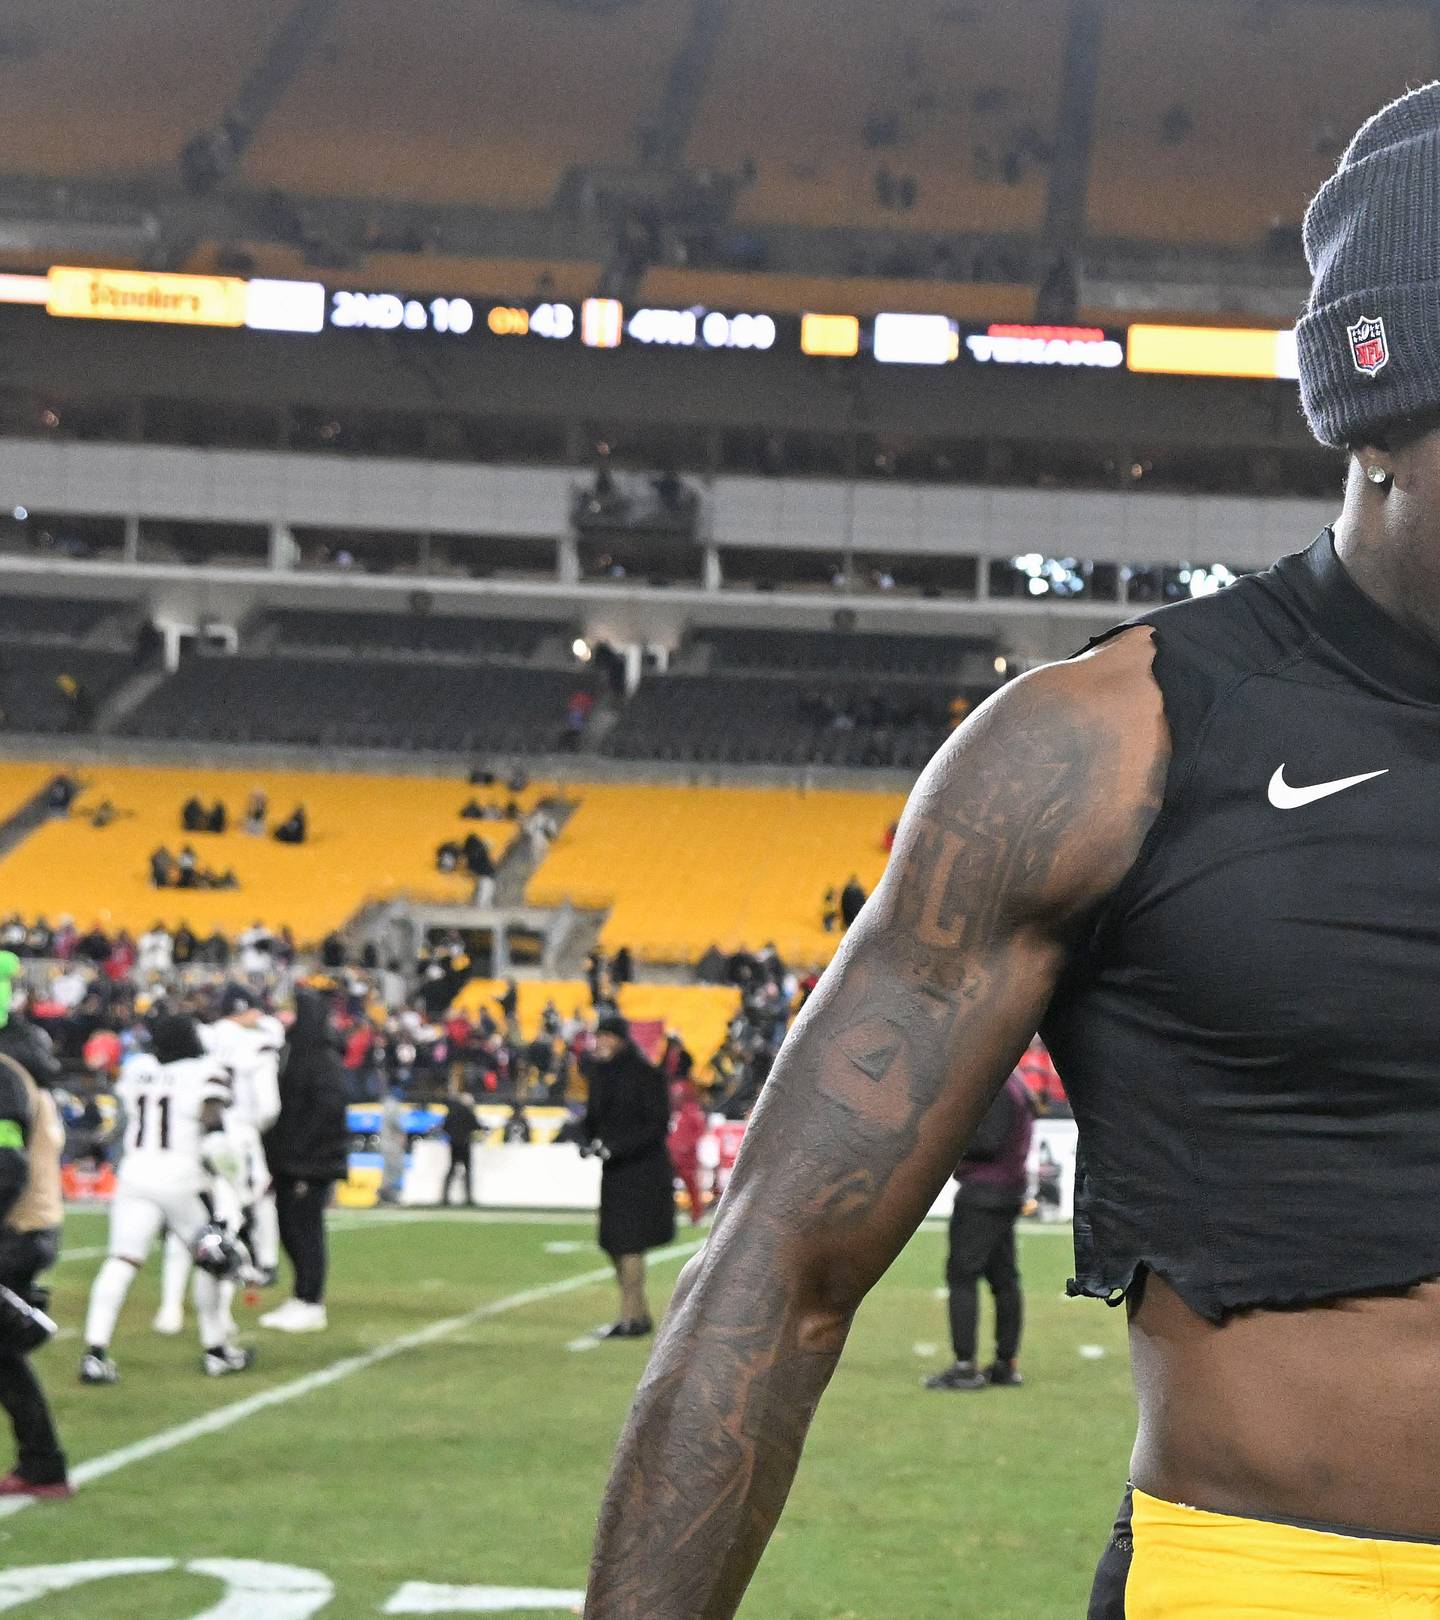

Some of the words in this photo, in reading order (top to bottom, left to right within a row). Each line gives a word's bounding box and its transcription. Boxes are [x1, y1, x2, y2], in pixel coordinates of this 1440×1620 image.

[430, 297, 474, 334] 10
[530, 303, 574, 339] 43
[135, 1094, 170, 1149] 11
